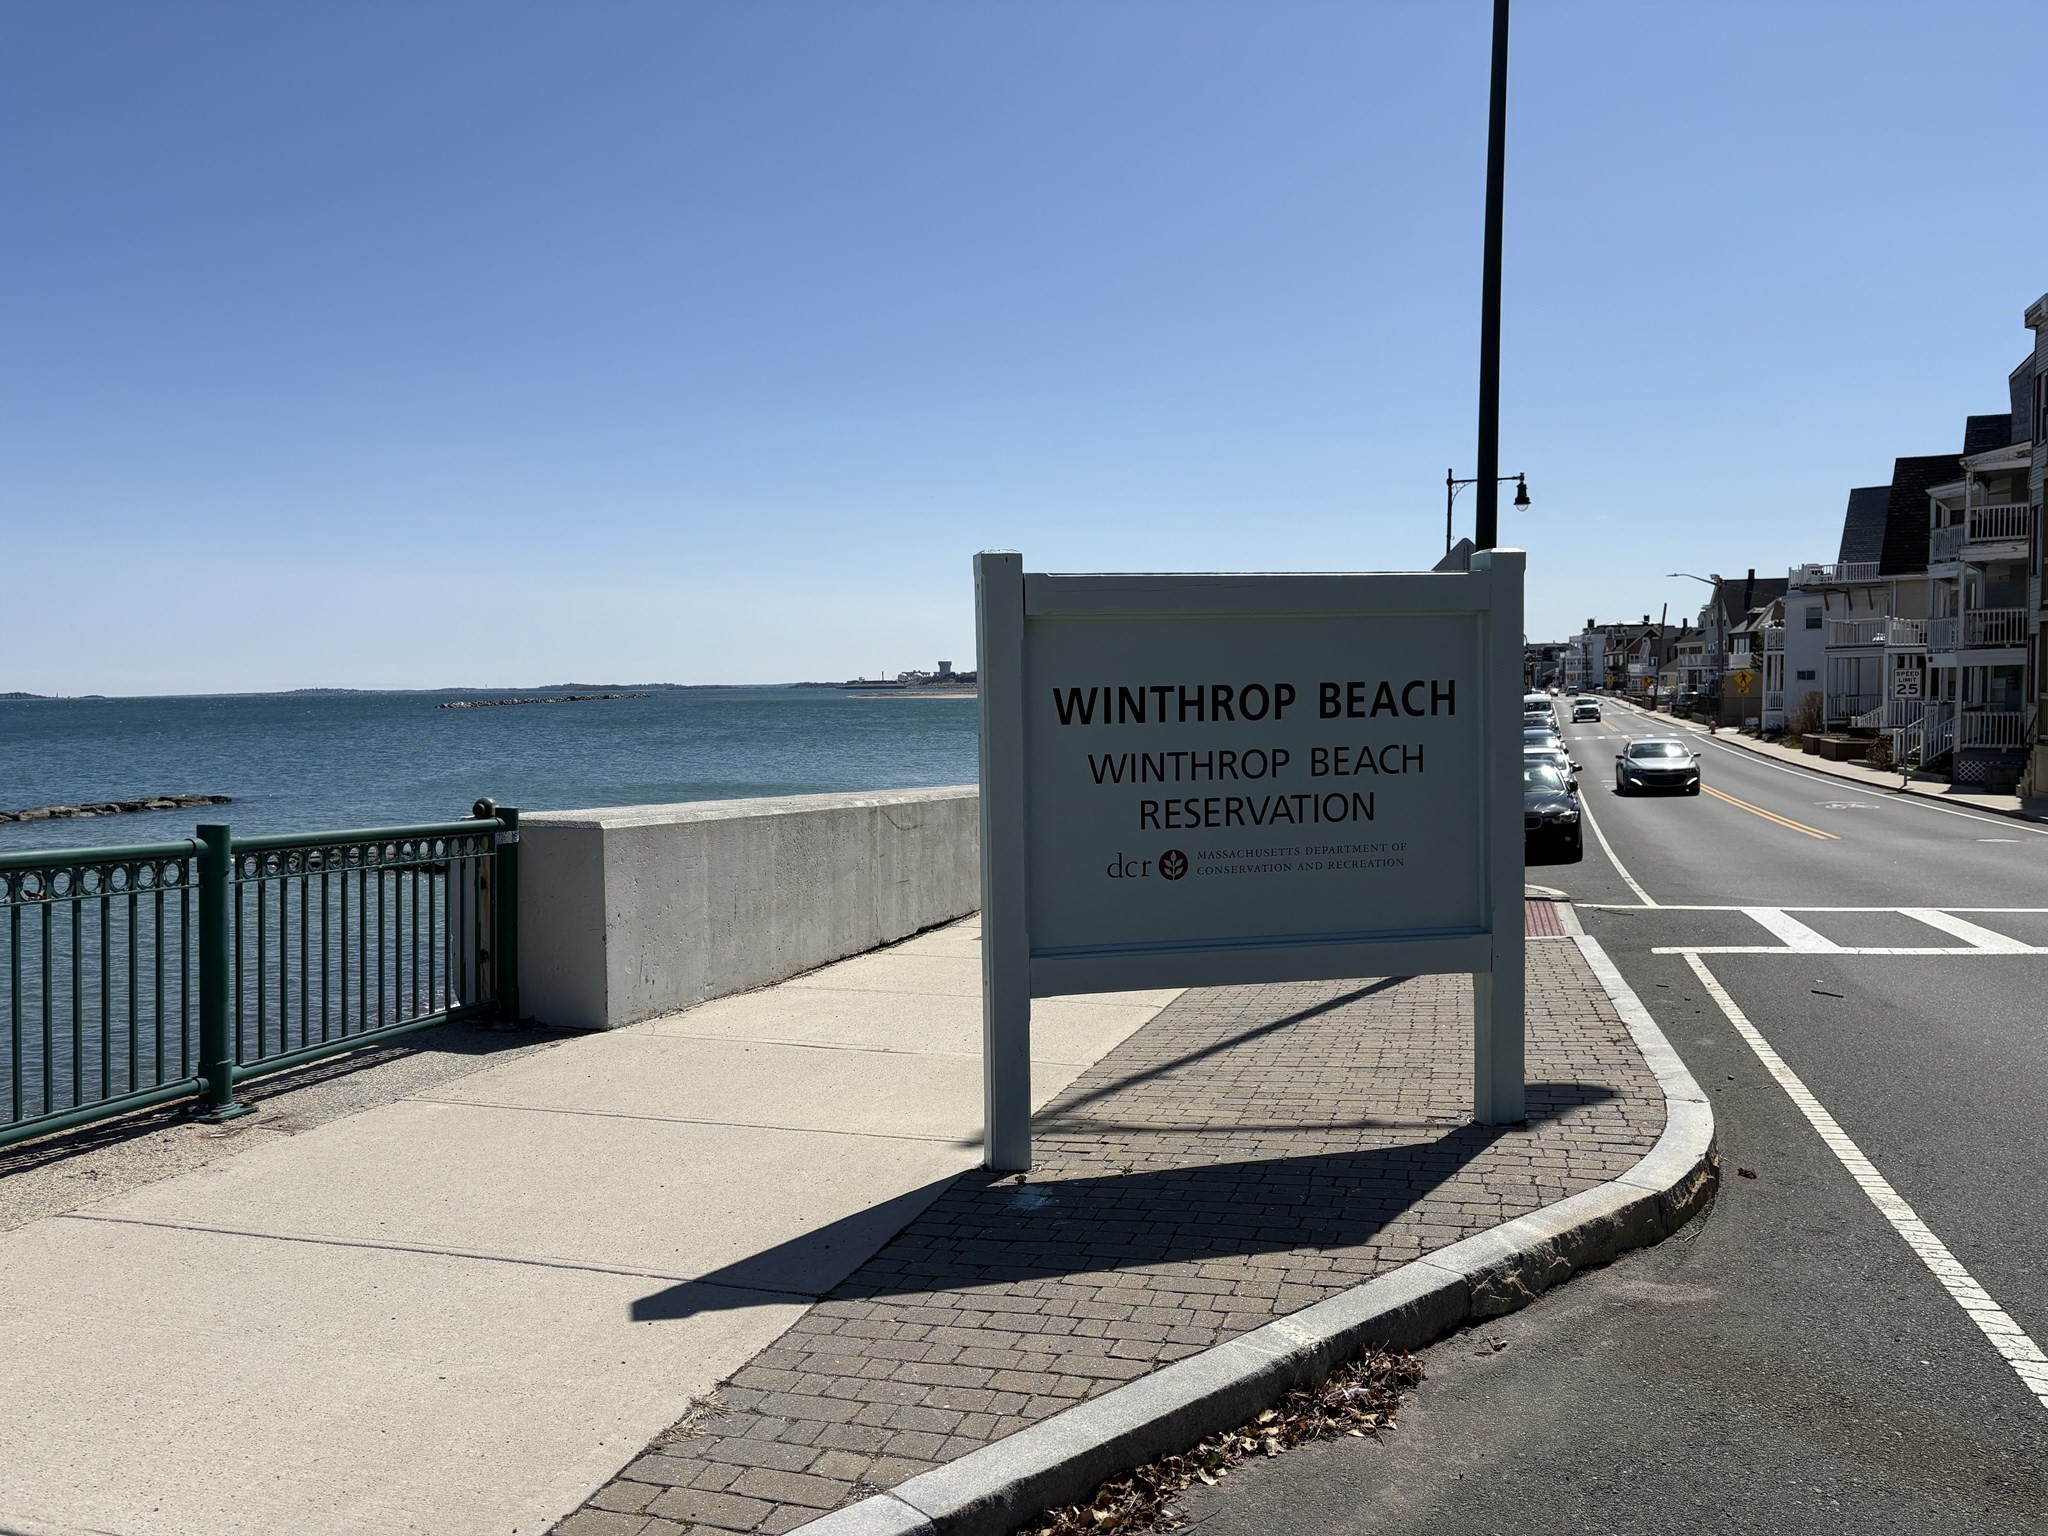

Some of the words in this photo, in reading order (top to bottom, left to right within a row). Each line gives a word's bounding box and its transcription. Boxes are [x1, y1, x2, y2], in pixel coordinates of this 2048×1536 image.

[1896, 683, 1918, 695] 25
[1052, 682, 1297, 726] WINTHROP
[1318, 679, 1457, 719] BEACH
[1087, 748, 1291, 784] WINTHROP
[1310, 743, 1425, 777] BEACH
[1139, 791, 1376, 830] RESERVATION
[1197, 847, 1301, 860] MASSACHUSETTS
[1304, 843, 1388, 856] DEPARTMENT
[1391, 842, 1407, 852] OF
[1106, 852, 1153, 878] dcr
[1196, 863, 1292, 876] CONSERVATION
[1297, 861, 1323, 871] AND
[1327, 858, 1405, 870] RECREATION
